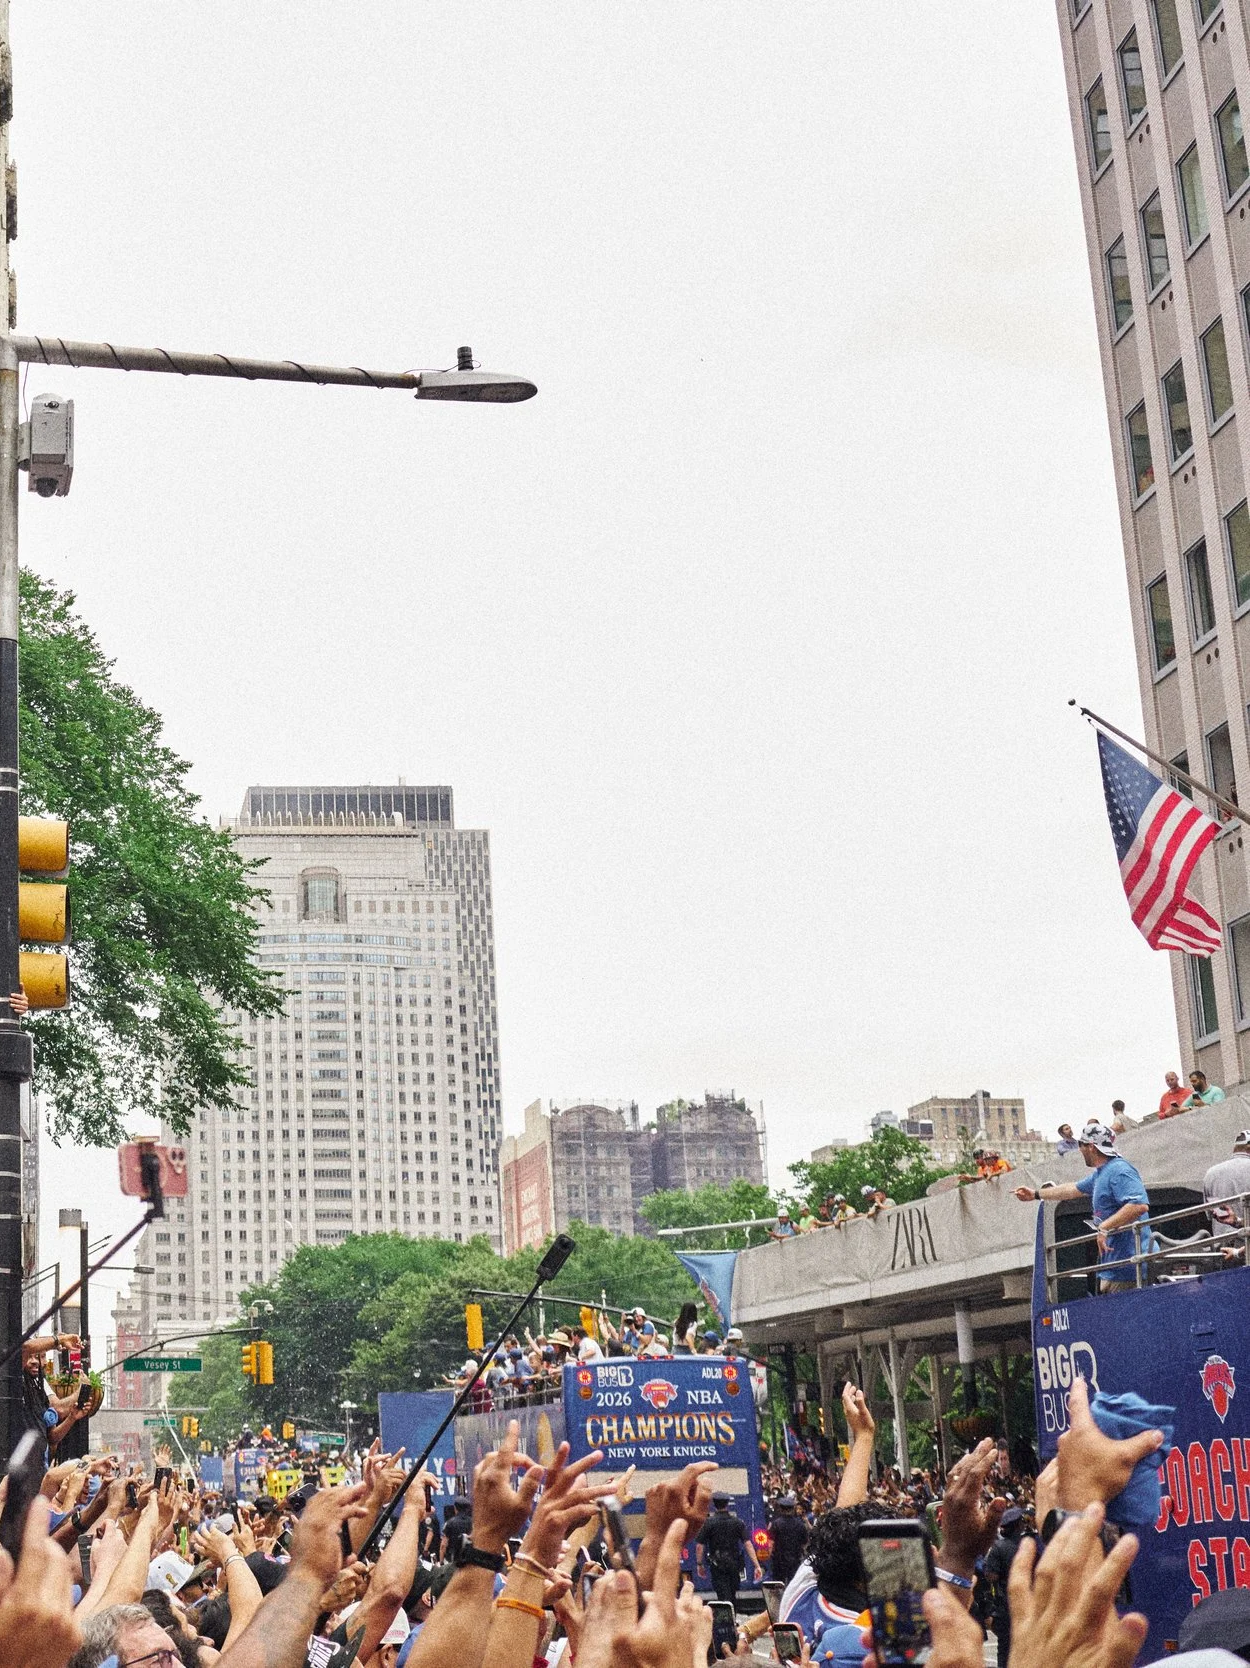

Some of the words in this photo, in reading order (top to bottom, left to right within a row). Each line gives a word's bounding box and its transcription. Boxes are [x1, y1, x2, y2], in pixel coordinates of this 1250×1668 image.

[887, 1204, 939, 1271] ZARA
[1052, 1307, 1071, 1333] ADL21
[144, 1360, 170, 1371] Vesey
[172, 1361, 181, 1370] St
[596, 1366, 617, 1378] BIG
[1036, 1344, 1071, 1390] BIG
[701, 1367, 723, 1380] ADL20
[597, 1377, 618, 1388] BUS
[596, 1392, 632, 1407] 2026
[686, 1390, 724, 1405] NBA
[585, 1410, 736, 1449] CHAMPIONS
[608, 1448, 637, 1458] NEW
[639, 1447, 671, 1458] YORK
[673, 1446, 717, 1457] KNICKS
